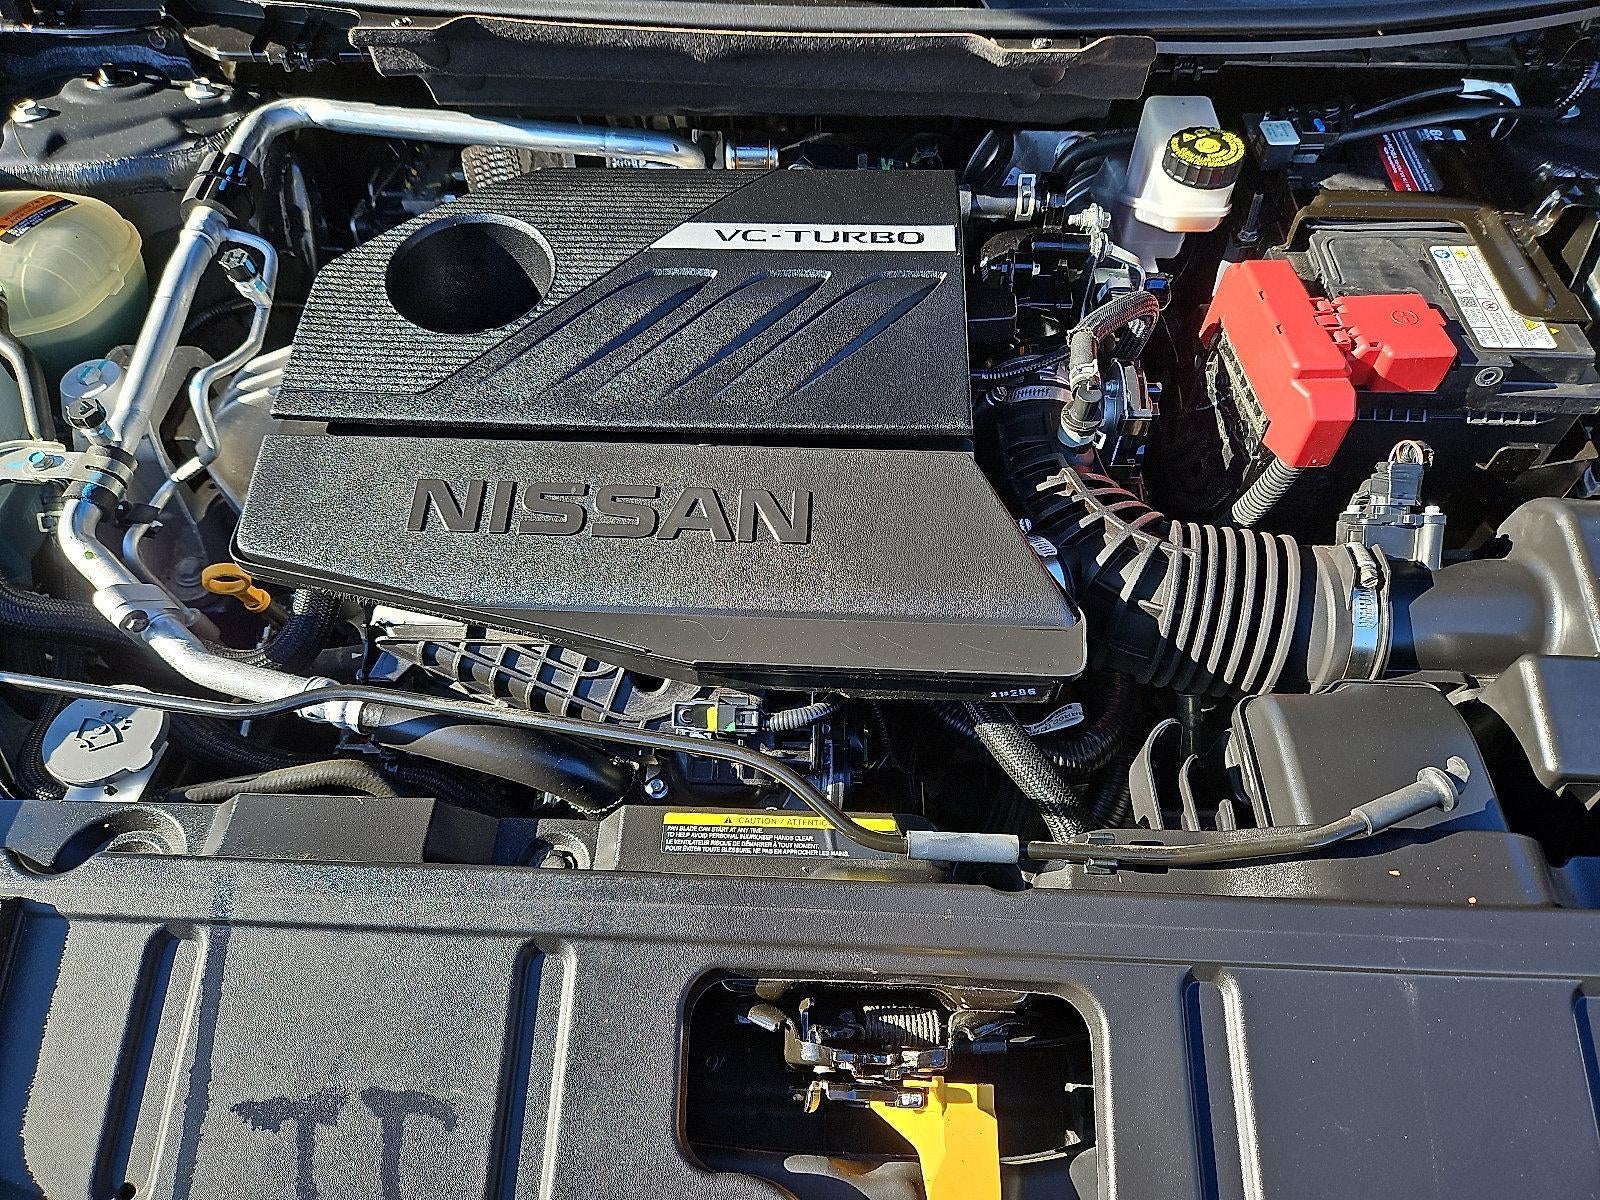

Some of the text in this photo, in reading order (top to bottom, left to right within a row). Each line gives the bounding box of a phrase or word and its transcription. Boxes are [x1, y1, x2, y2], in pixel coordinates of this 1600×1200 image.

[714, 228, 925, 245] VC-TURBO
[407, 479, 813, 544] NISSAN
[738, 817, 777, 825] CAUTION
[787, 819, 832, 827] ATTENTIO
